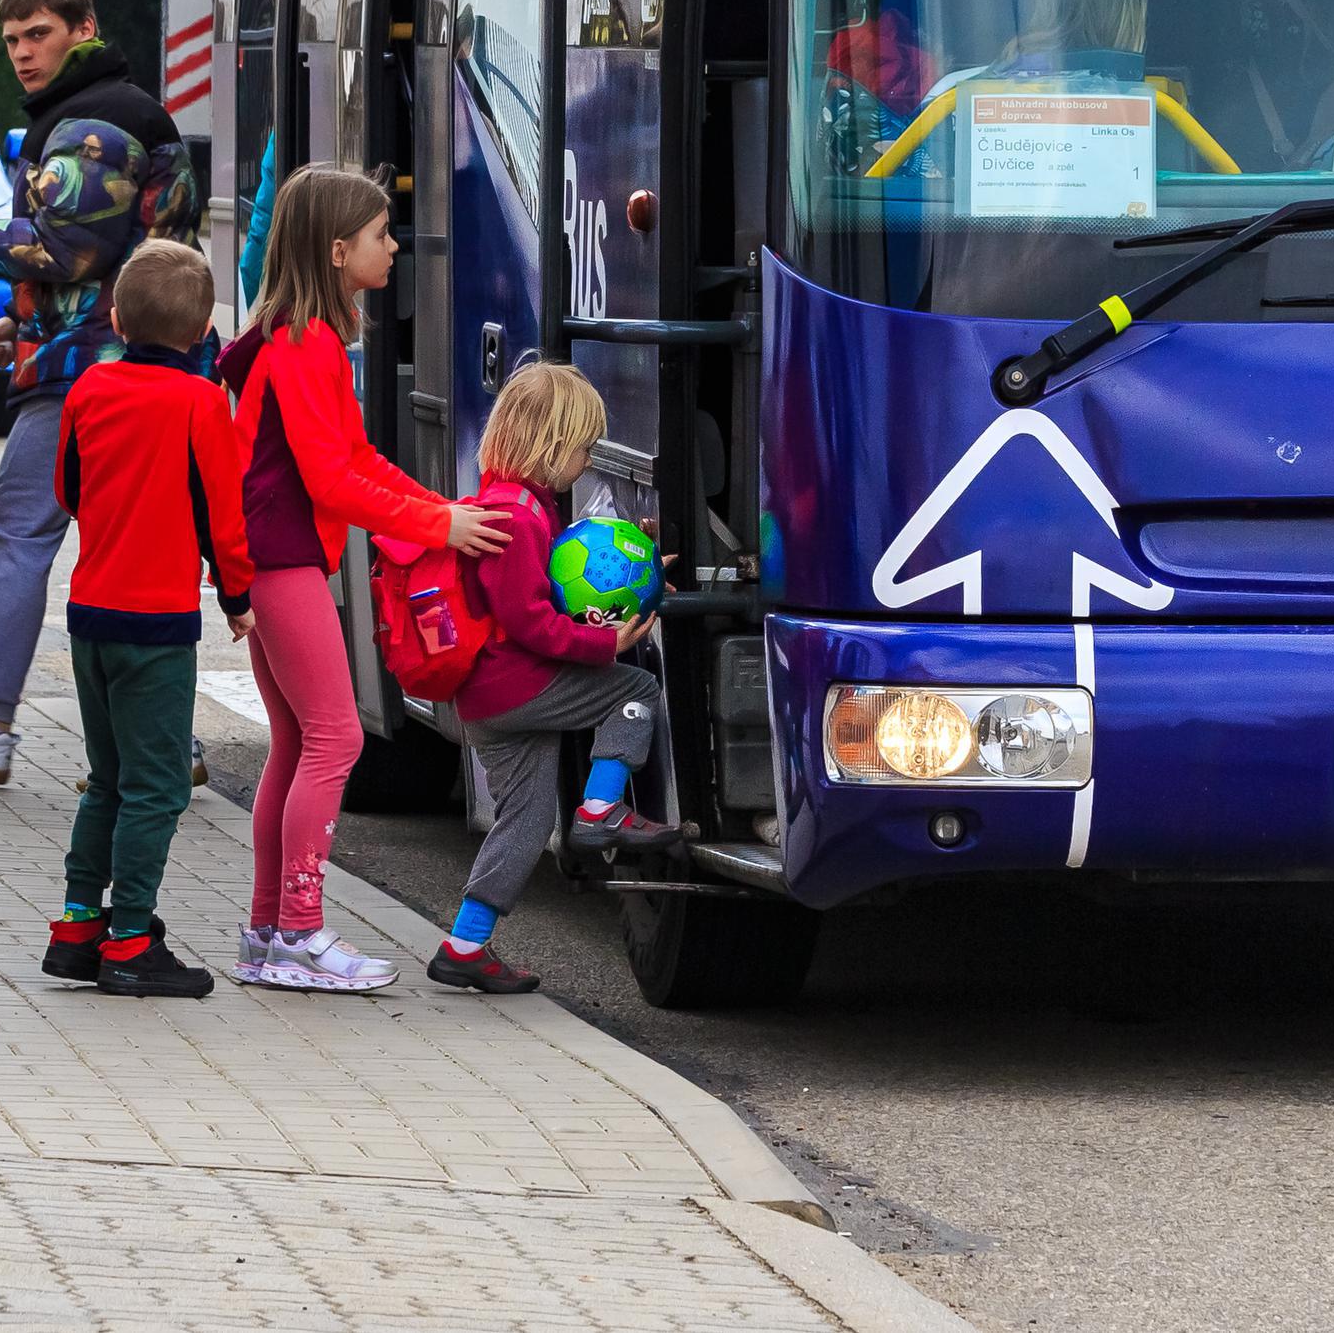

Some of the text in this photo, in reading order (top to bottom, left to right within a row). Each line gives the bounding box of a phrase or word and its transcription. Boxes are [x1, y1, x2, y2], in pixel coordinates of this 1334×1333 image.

[1050, 100, 1108, 110] autobusová
[1001, 110, 1042, 122] doprava
[1091, 127, 1135, 137] Linka Os
[977, 136, 1073, 154] Č.Budějovice
[1132, 167, 1140, 180] 1
